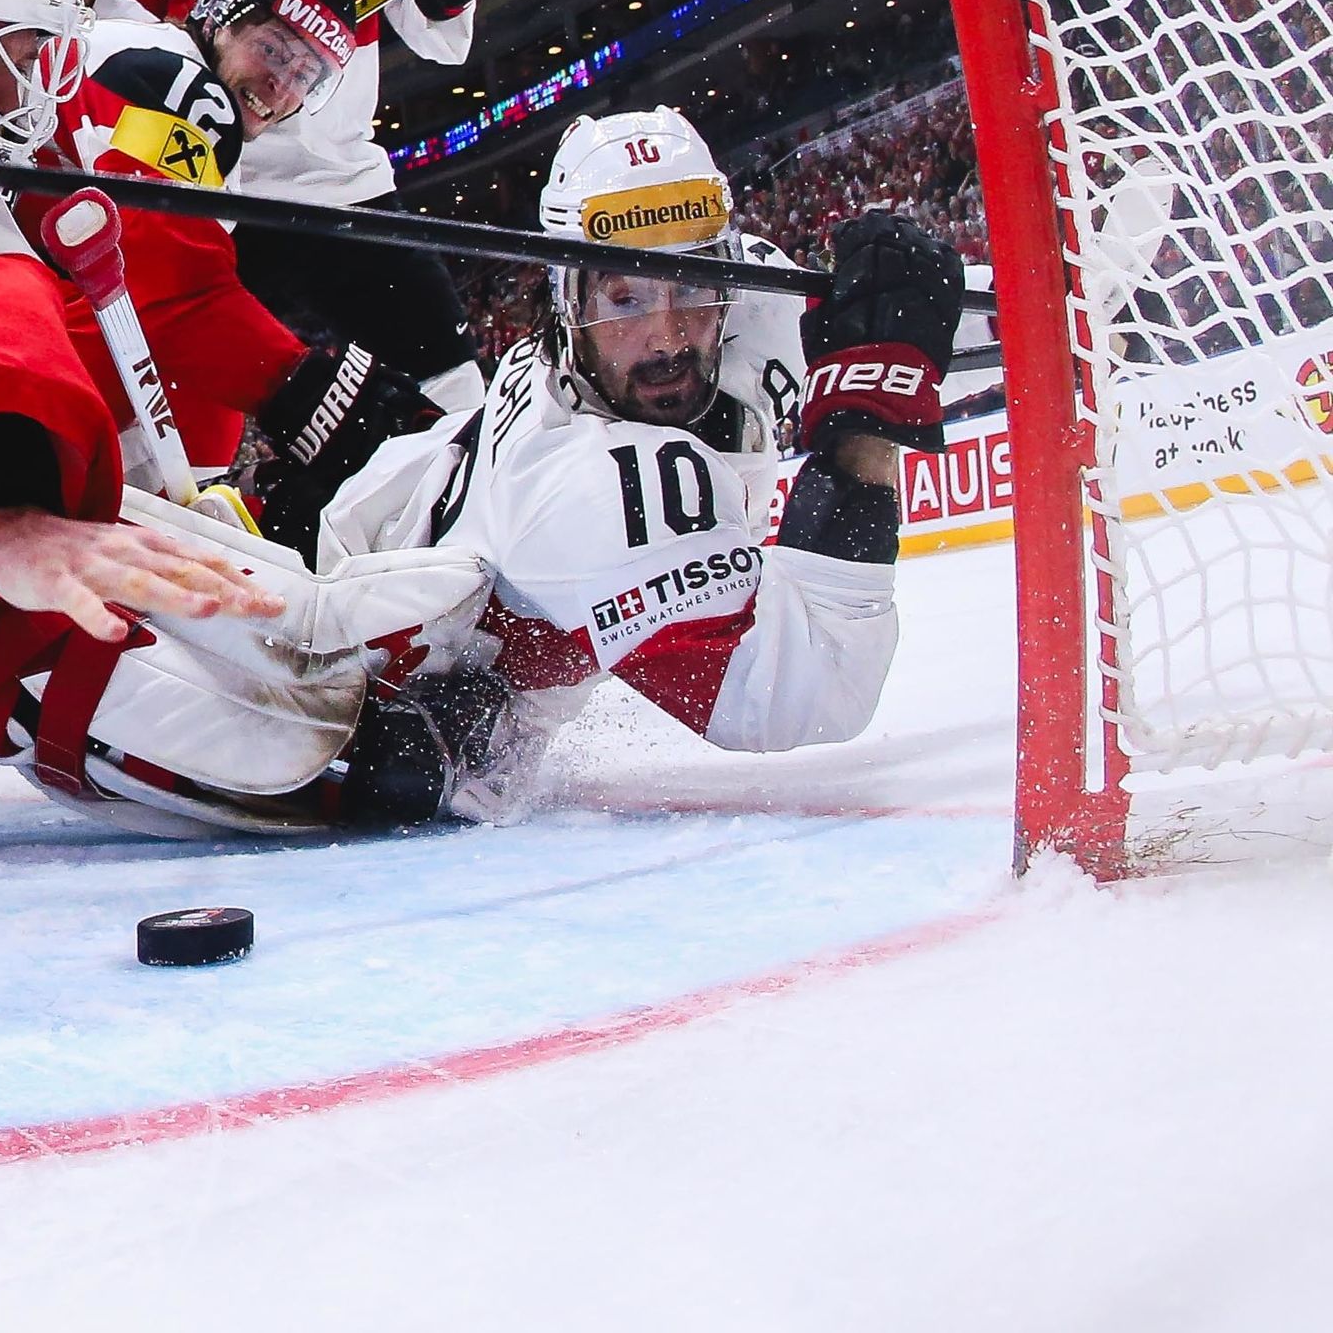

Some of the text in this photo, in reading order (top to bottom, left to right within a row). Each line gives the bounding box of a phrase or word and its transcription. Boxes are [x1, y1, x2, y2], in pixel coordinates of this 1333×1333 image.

[164, 57, 236, 147] 12
[625, 138, 661, 166] 10
[588, 194, 709, 240] Continental
[1155, 442, 1179, 468] at
[608, 441, 718, 549] 10
[645, 546, 764, 604] TISSOT
[647, 591, 711, 626] WATCHES
[718, 577, 752, 596] SINCE
